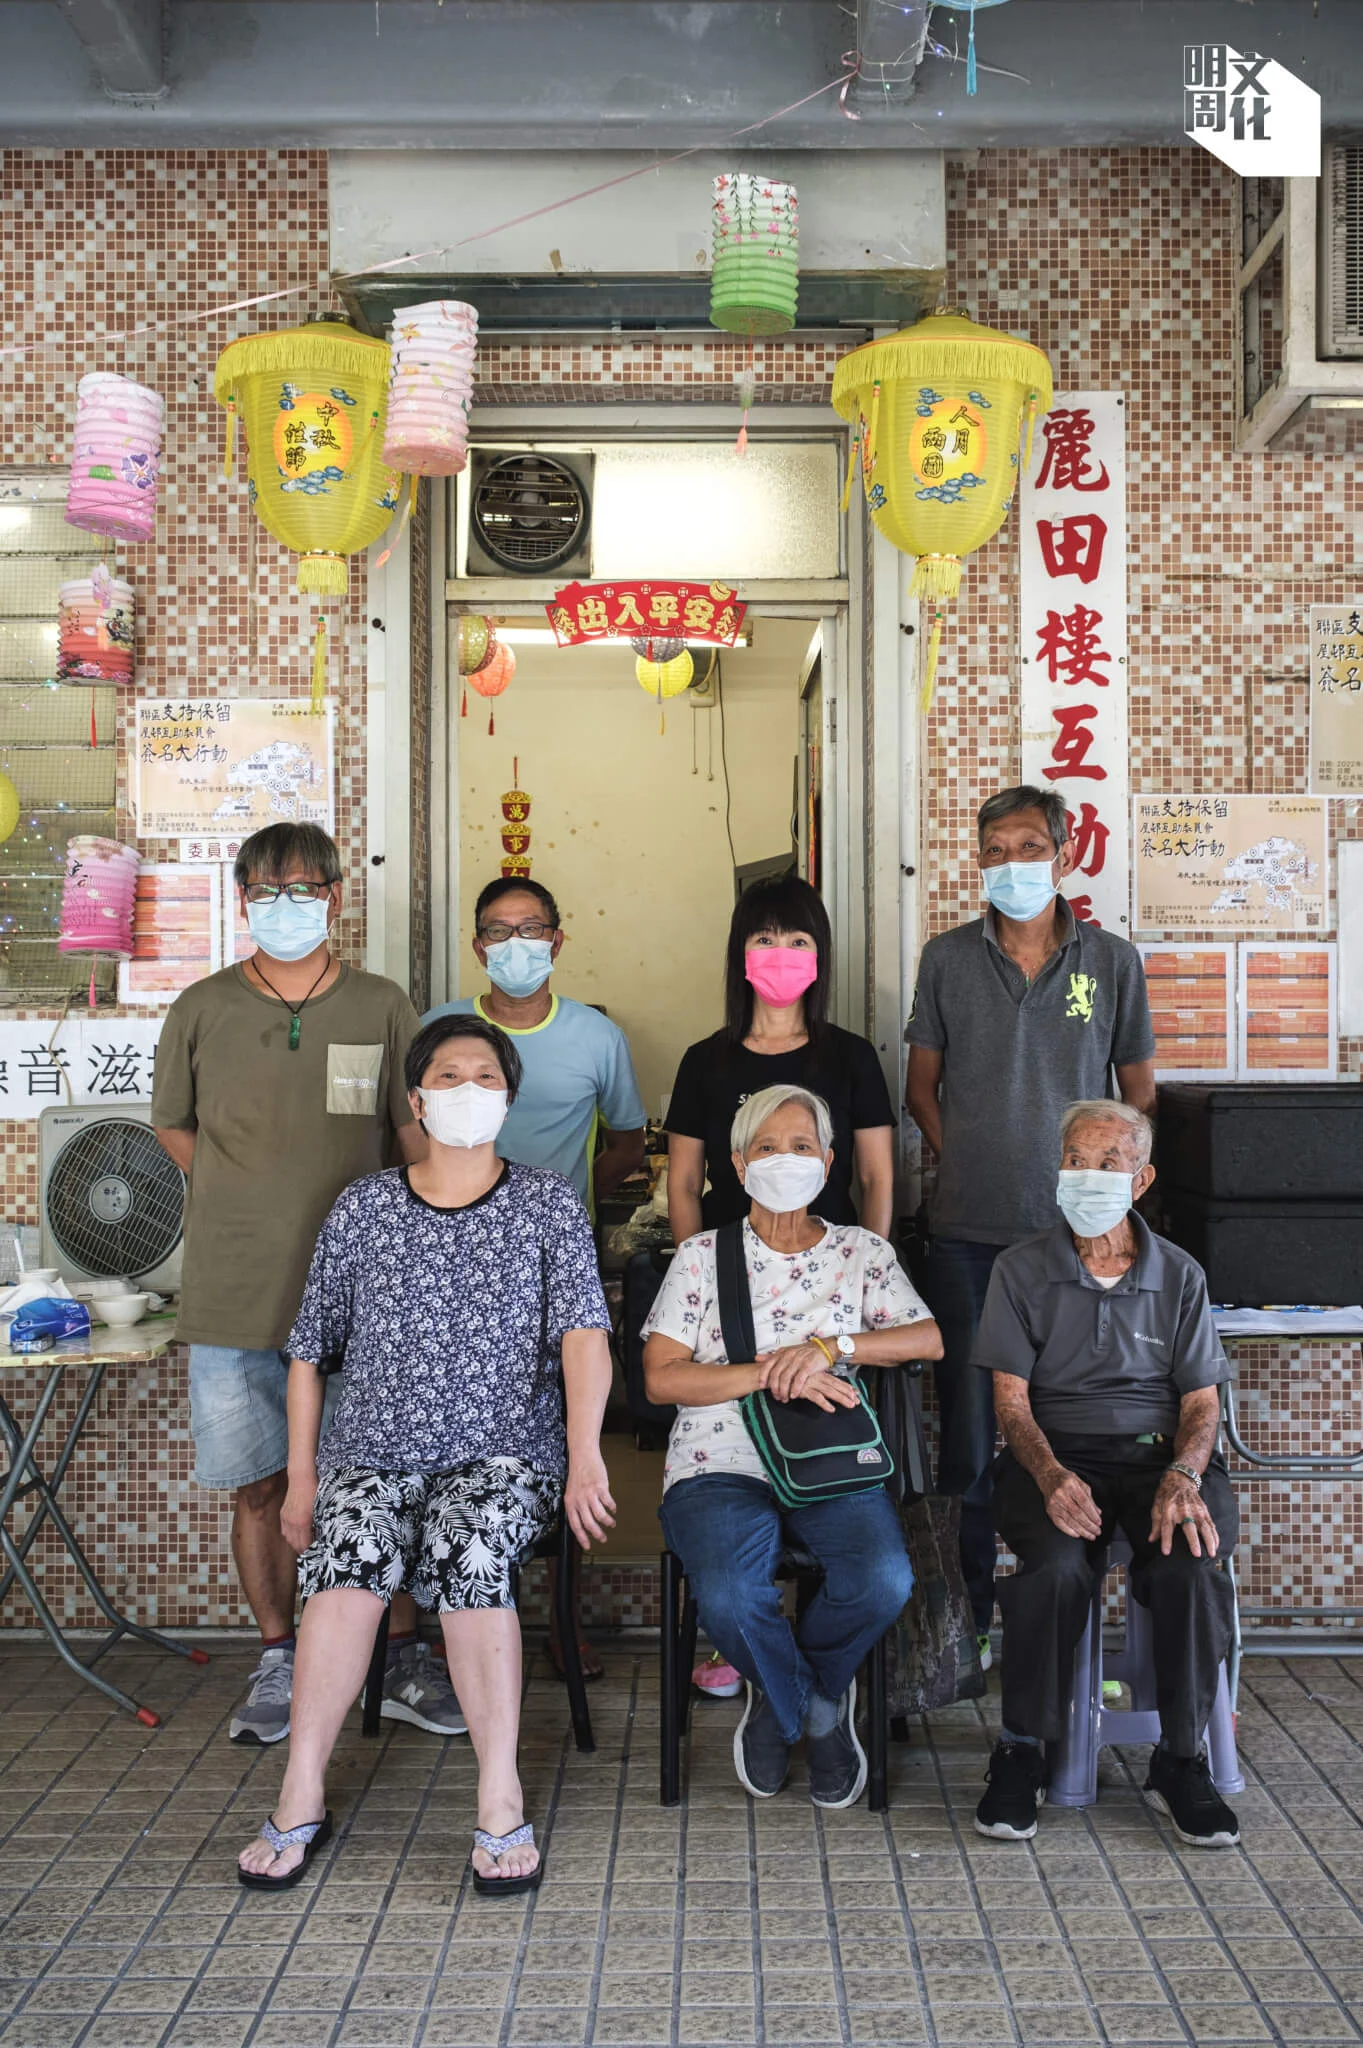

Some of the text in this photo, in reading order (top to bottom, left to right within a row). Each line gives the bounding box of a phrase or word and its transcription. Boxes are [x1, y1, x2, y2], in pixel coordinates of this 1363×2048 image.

[309, 401, 341, 450] 中秋
[950, 405, 980, 456] 人月
[576, 594, 716, 632] 出入平安
[1034, 408, 1112, 929] 麗田樓互助
[140, 726, 216, 743] 屋邨互助委員會
[140, 743, 228, 763] 簽名大行動
[1140, 822, 1214, 836] 屋邨互助委員會
[187, 842, 241, 858] 委員會
[1140, 838, 1225, 858] 簽名大行動
[0, 1043, 158, 1096] 音滋
